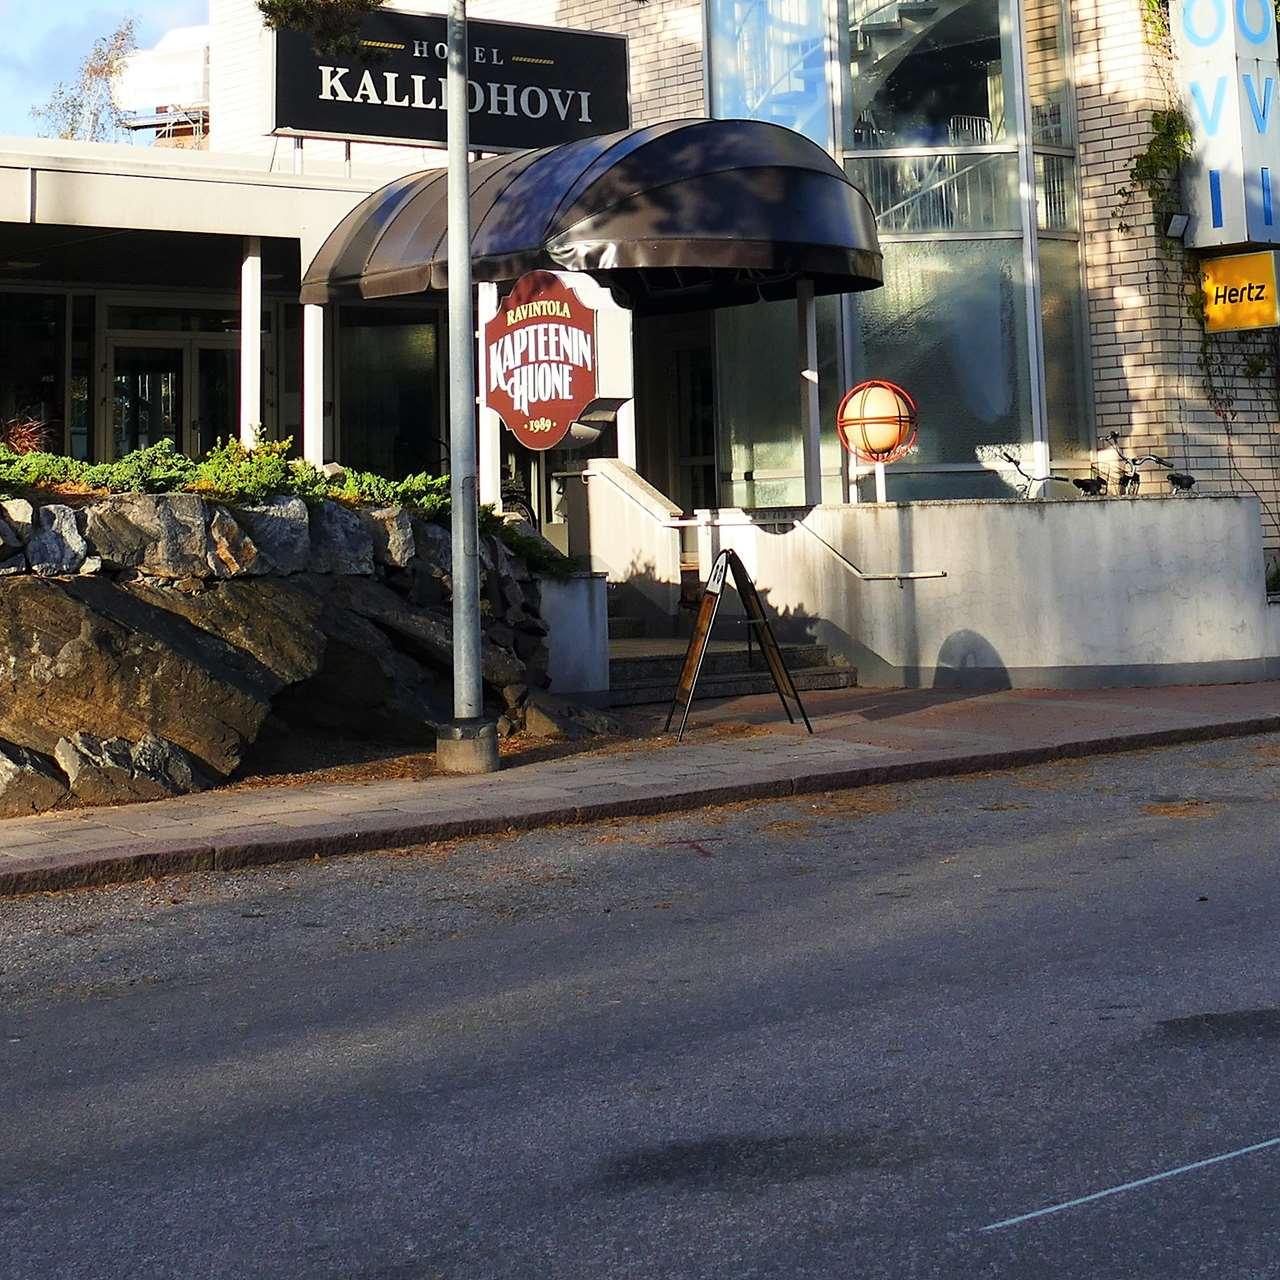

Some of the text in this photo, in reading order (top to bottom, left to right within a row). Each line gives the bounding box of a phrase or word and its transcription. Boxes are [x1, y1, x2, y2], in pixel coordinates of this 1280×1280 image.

[413, 40, 504, 66] HOEL
[1214, 282, 1266, 305] Hertz
[506, 300, 571, 326] RAVINTOLA
[489, 323, 592, 392] KAPTEENIN
[507, 362, 573, 416] HUONE
